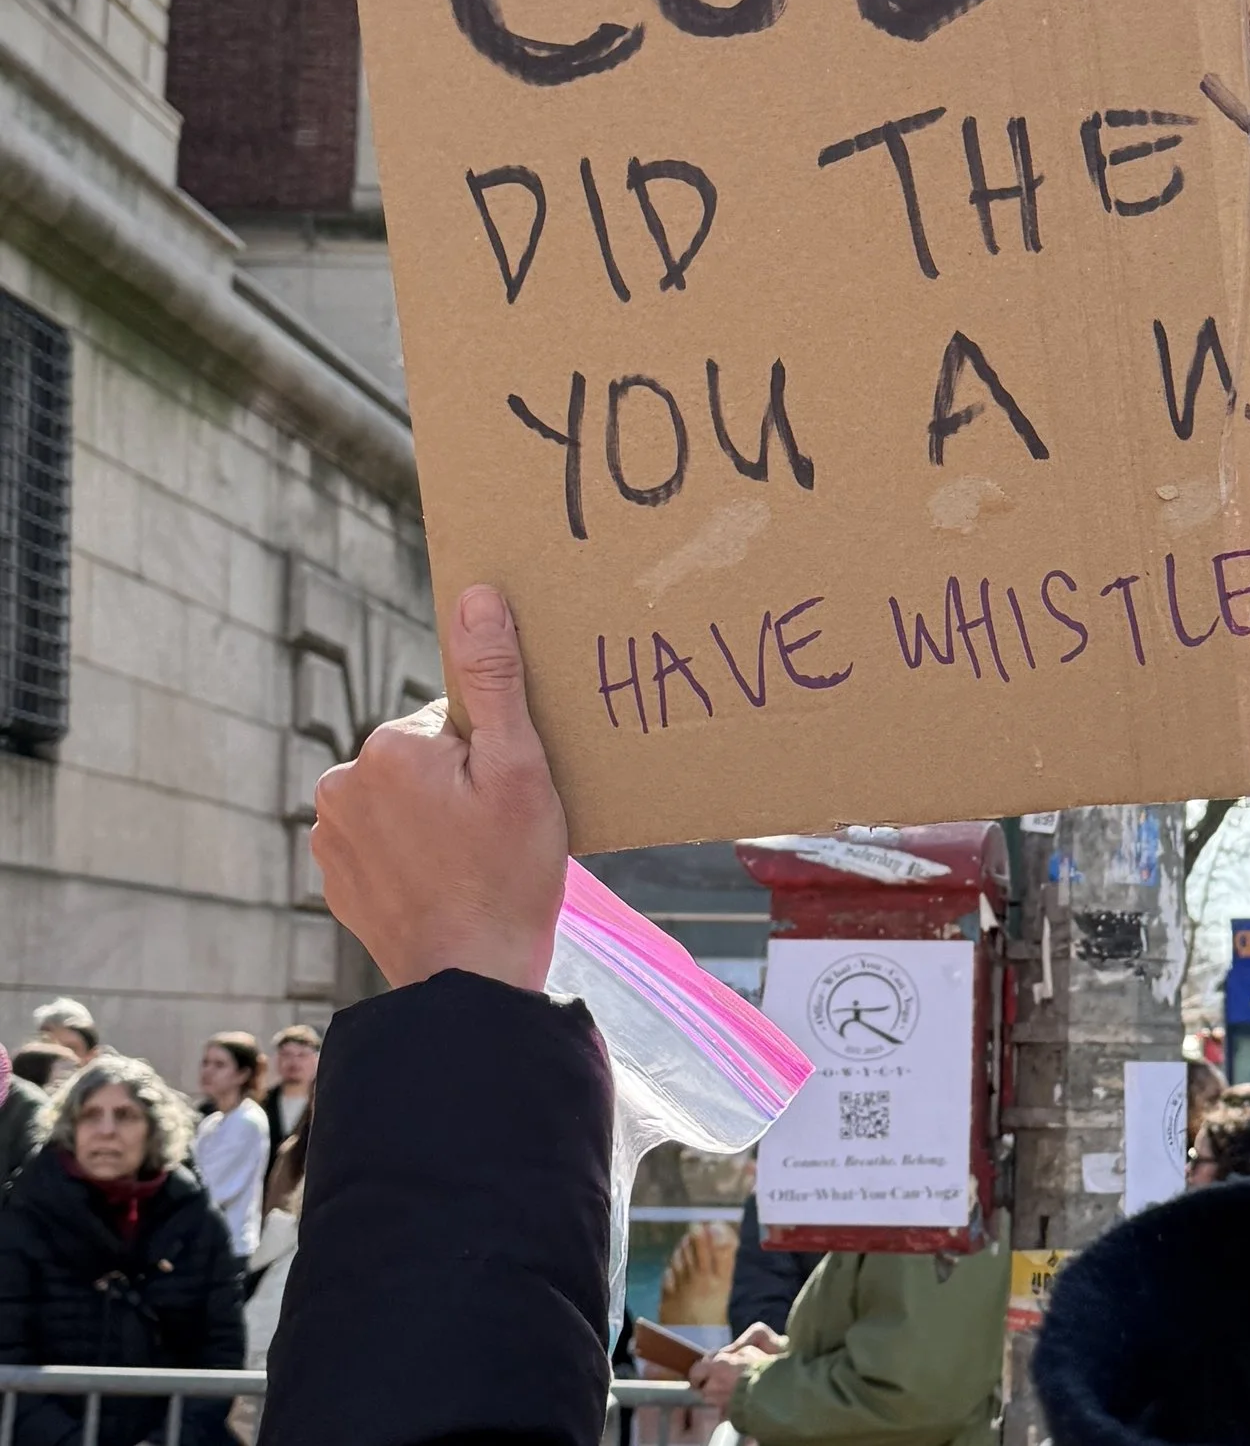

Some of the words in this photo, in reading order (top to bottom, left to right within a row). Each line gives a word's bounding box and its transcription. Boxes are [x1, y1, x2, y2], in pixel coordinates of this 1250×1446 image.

[466, 156, 718, 305] DID
[506, 357, 815, 541] YOU
[927, 329, 1050, 467] A
[597, 596, 854, 735] HAVE
